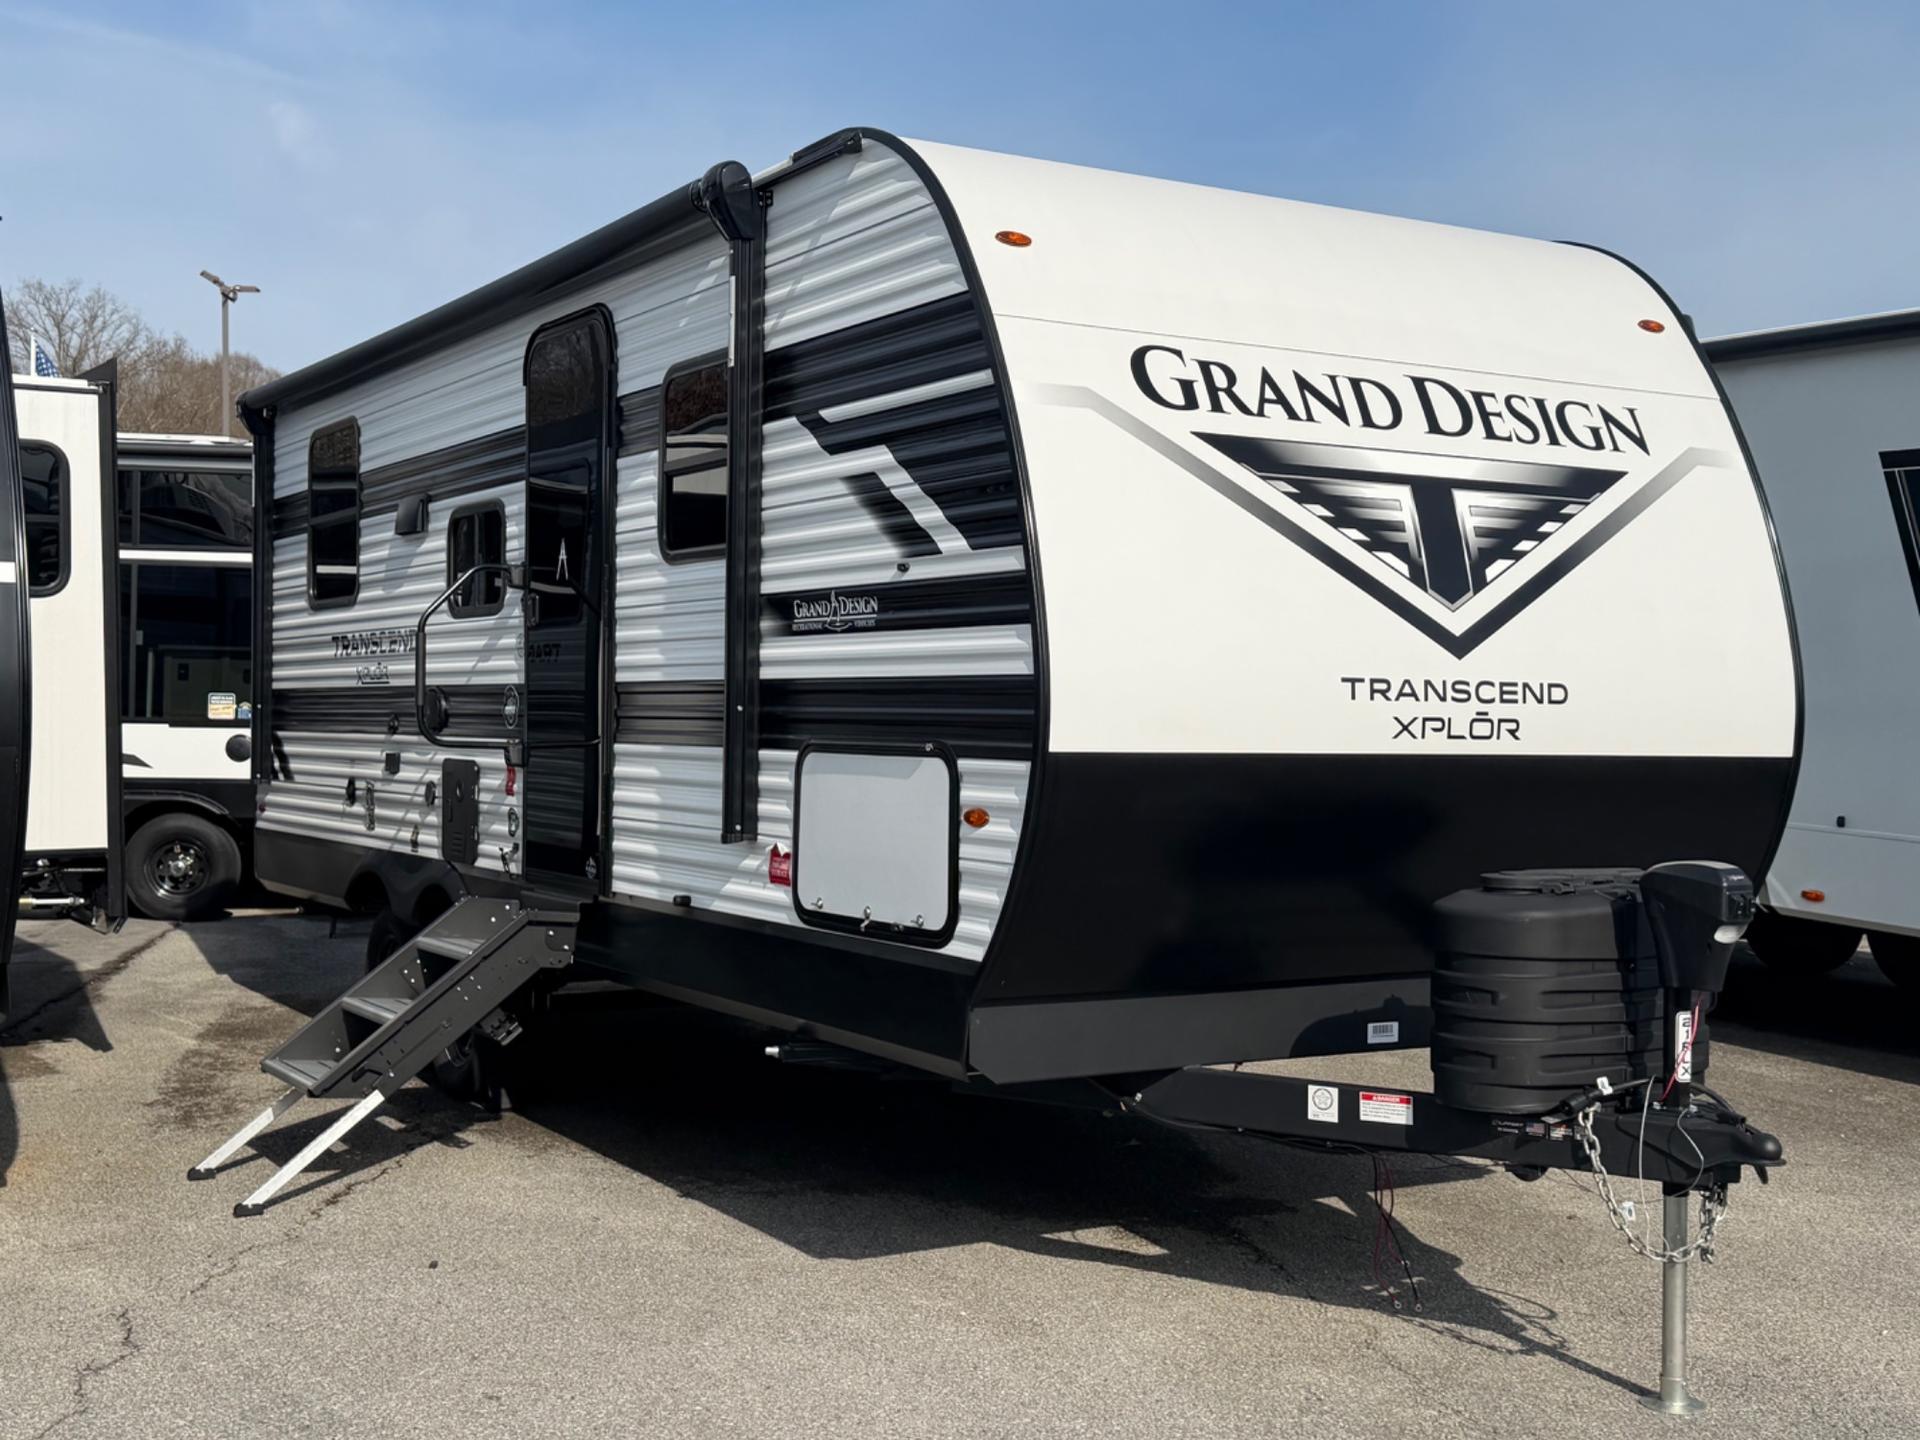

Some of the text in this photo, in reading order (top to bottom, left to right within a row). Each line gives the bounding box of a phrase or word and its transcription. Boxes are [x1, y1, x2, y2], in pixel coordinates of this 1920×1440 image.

[1130, 344, 1651, 457] GRAND DESIGN
[793, 596, 879, 618] GRAND DESIGN
[1341, 677, 1569, 705] TRANSCEND
[1392, 711, 1521, 741] XPLŌR
